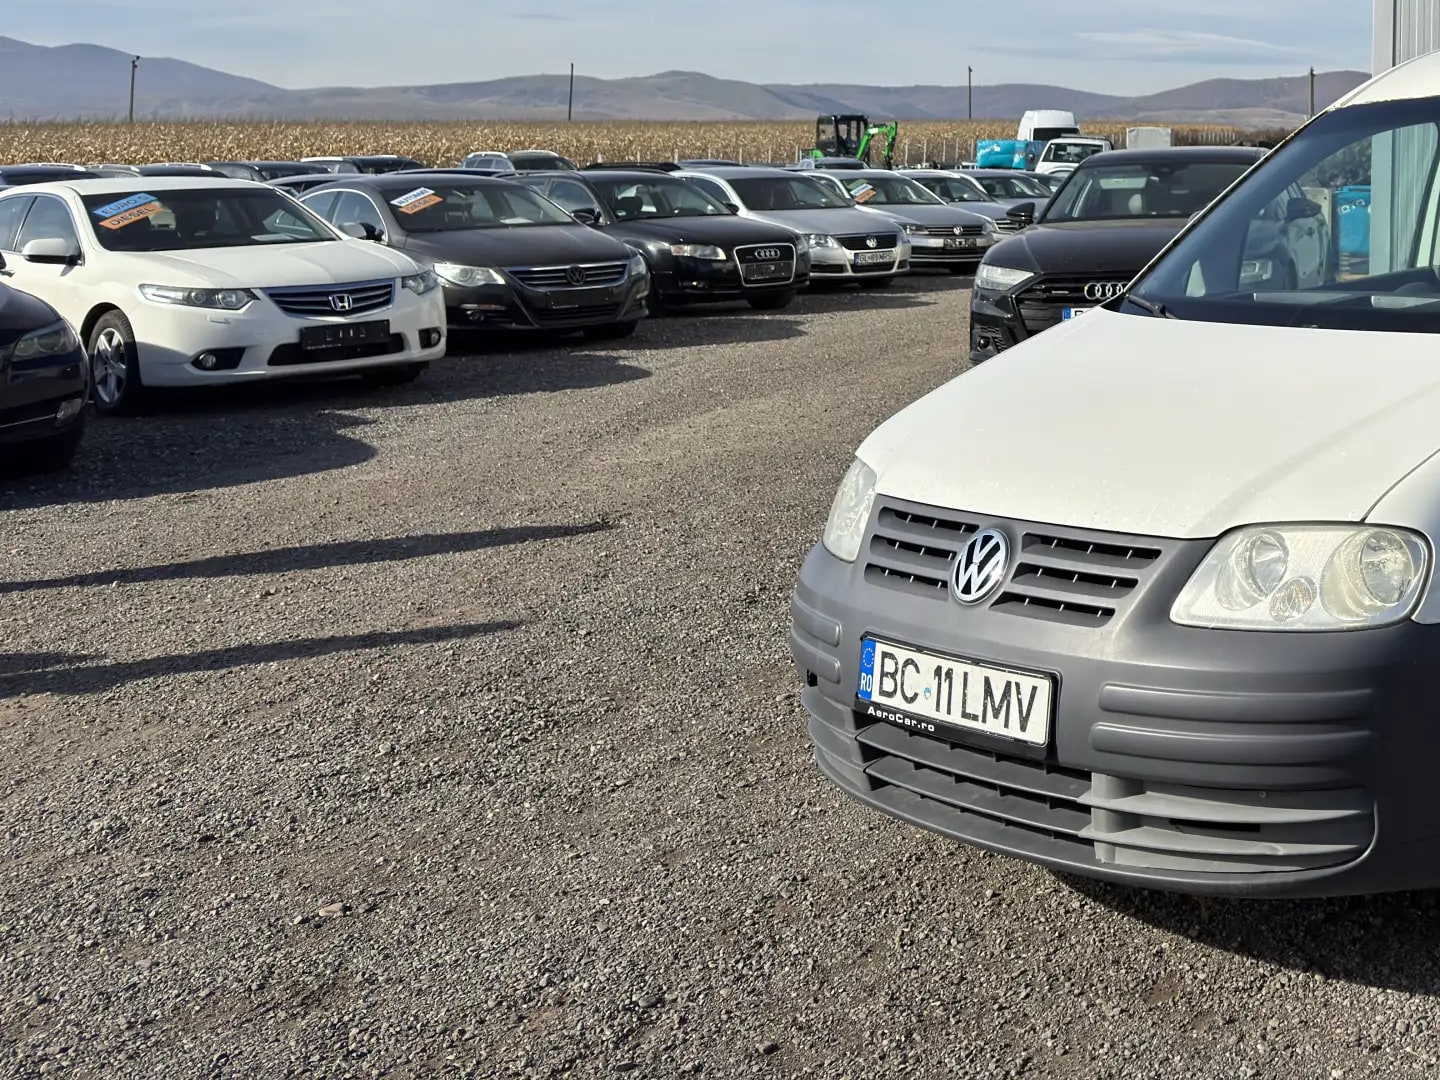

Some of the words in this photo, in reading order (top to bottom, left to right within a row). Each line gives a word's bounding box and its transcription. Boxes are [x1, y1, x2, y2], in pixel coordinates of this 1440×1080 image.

[102, 199, 138, 214] EURO
[110, 204, 156, 226] DIESEL
[861, 672, 872, 693] RO
[878, 650, 920, 705] BC
[934, 665, 954, 716] 11
[961, 671, 1038, 733] LMV
[867, 706, 935, 732] AeroCar.ro
